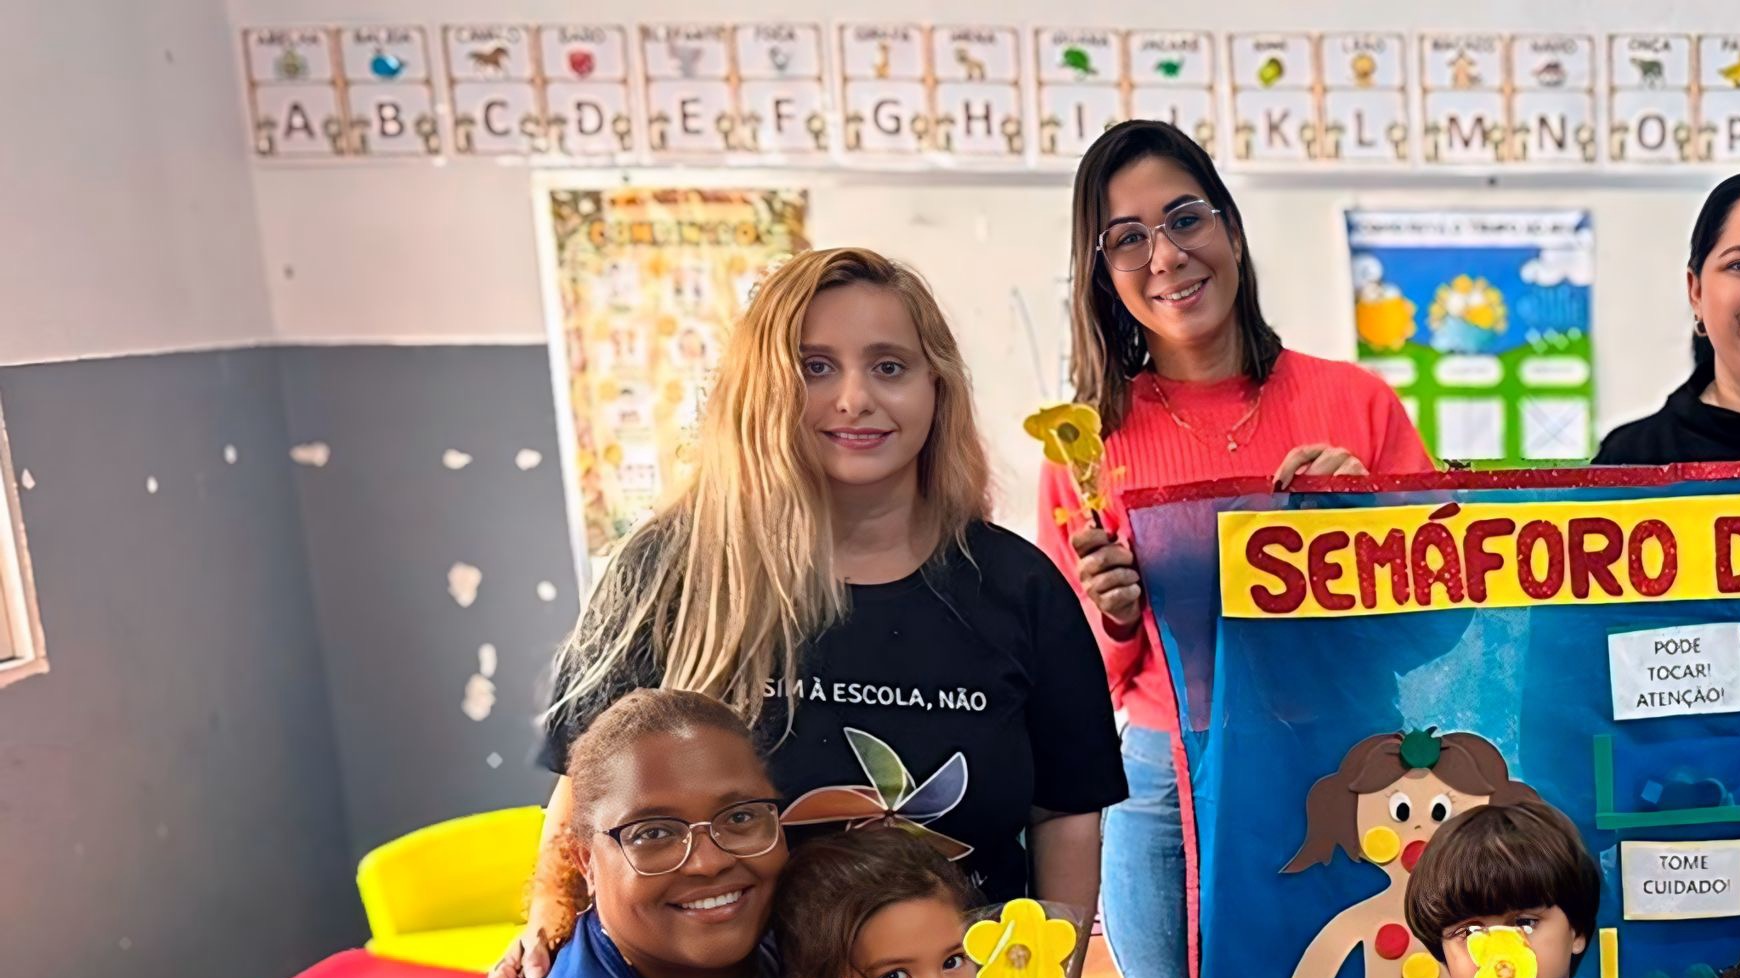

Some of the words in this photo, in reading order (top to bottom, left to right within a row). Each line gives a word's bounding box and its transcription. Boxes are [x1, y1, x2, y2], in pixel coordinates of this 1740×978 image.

[283, 104, 315, 140] A
[379, 104, 404, 138] B
[483, 101, 510, 137] C
[576, 102, 602, 136] D
[680, 99, 702, 135] E
[775, 99, 795, 135] F
[873, 100, 902, 135] G
[964, 101, 992, 137] H
[1076, 104, 1084, 138] I
[1266, 110, 1291, 147] K
[1355, 110, 1374, 147] L
[1446, 115, 1487, 151] M
[1538, 115, 1566, 150] N
[1637, 114, 1666, 150] O
[1246, 502, 1678, 614] SEMÁFORO
[1654, 638, 1701, 655] PODE
[1647, 663, 1711, 681] TOCAR!
[809, 676, 827, 702] À
[833, 682, 933, 711] ESCOLA,
[939, 687, 988, 712] NÃO
[1637, 686, 1725, 708] ATENÇÃO!
[1659, 855, 1709, 870] TOME
[1643, 879, 1731, 895] CUIDADO!
